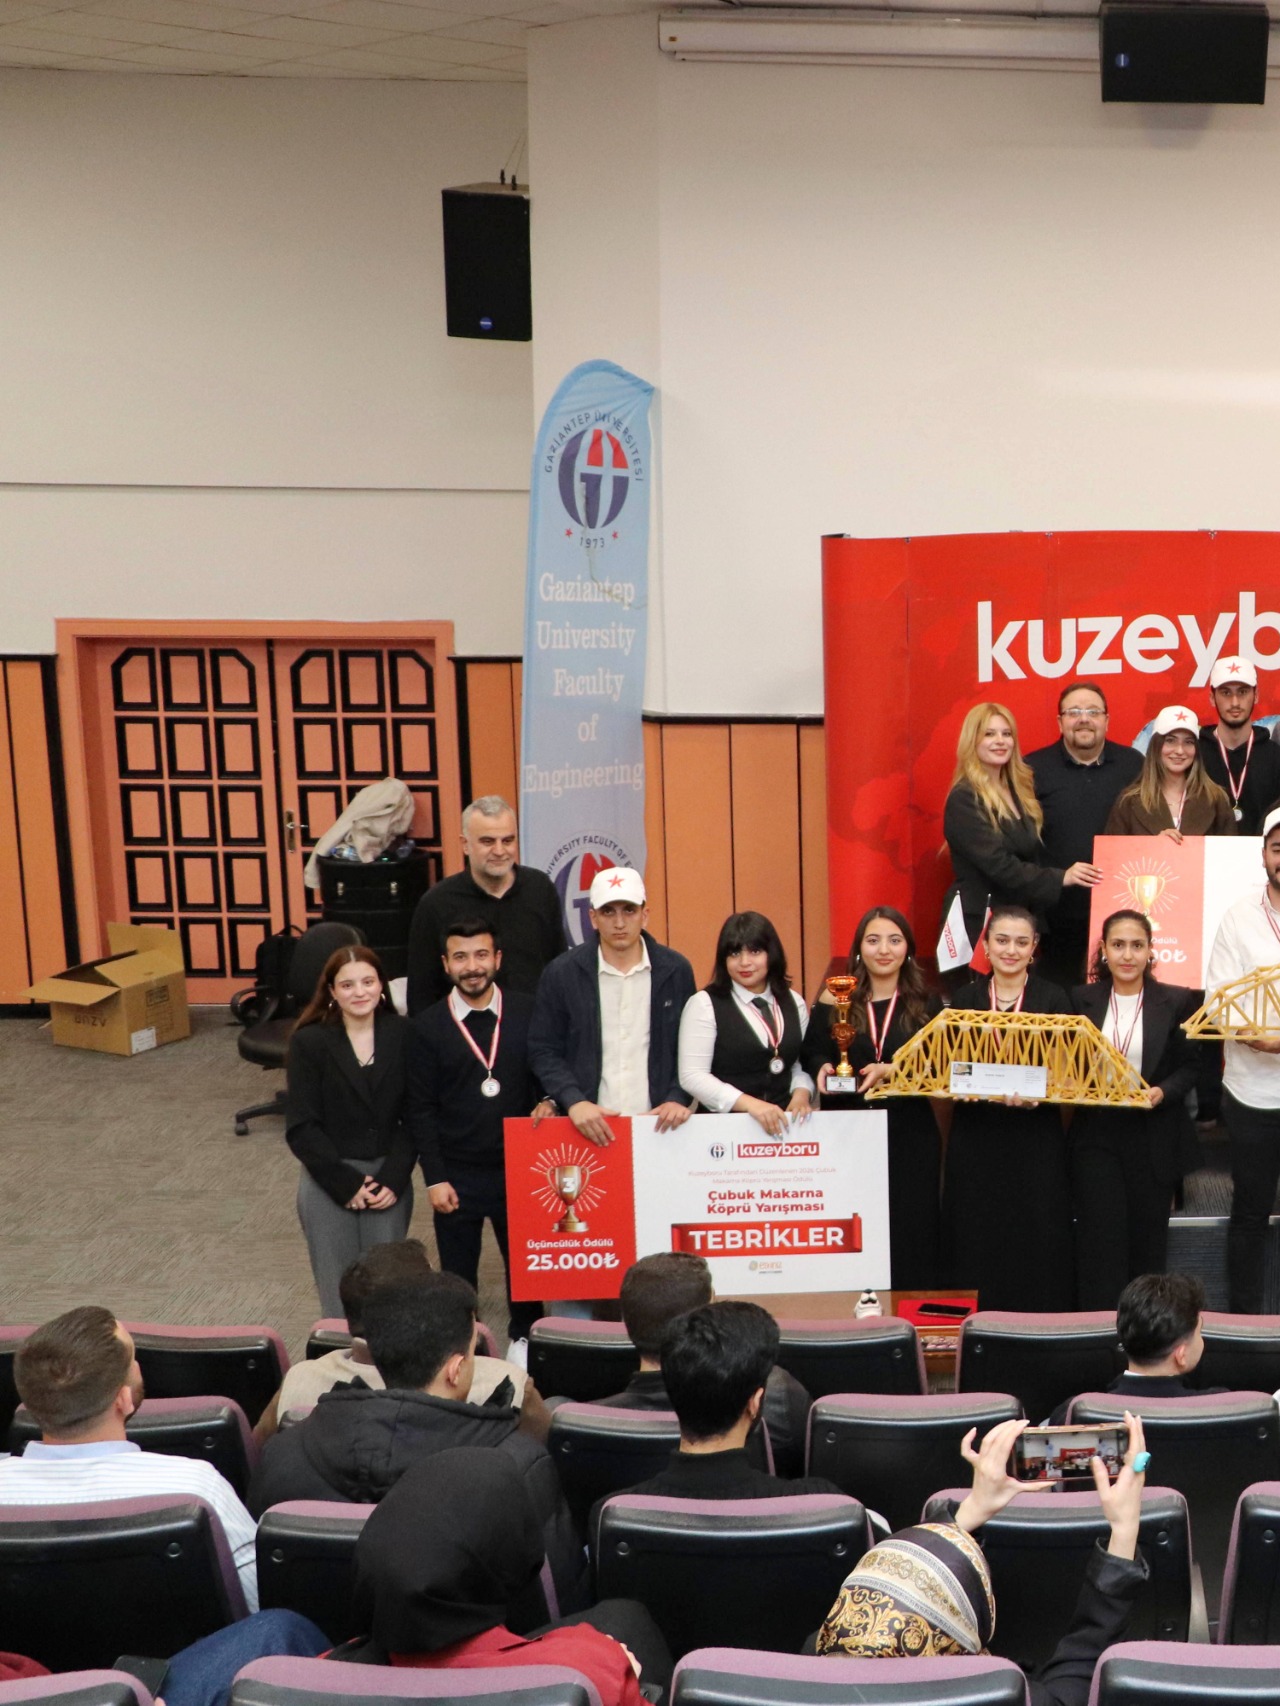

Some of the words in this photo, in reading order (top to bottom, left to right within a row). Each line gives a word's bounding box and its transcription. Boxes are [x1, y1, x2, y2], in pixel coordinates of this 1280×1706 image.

[580, 537, 605, 549] 1973
[538, 572, 636, 611] Gaziantep
[536, 620, 636, 656] University
[553, 667, 625, 701] Faculty
[577, 713, 600, 742] of
[523, 758, 645, 798] Engineering
[583, 835, 618, 850] FACULTY
[616, 848, 627, 860] OF
[740, 1142, 818, 1157] kuzeyboru
[562, 1177, 575, 1193] 3
[708, 1189, 756, 1203] Çubuk
[760, 1188, 824, 1200] Makarna
[707, 1201, 751, 1216] Köprü
[755, 1201, 825, 1215] Yarışması
[526, 1238, 581, 1250] Üçüncülük
[582, 1237, 614, 1247] Ödülü
[688, 1223, 845, 1250] TEBRİKLER
